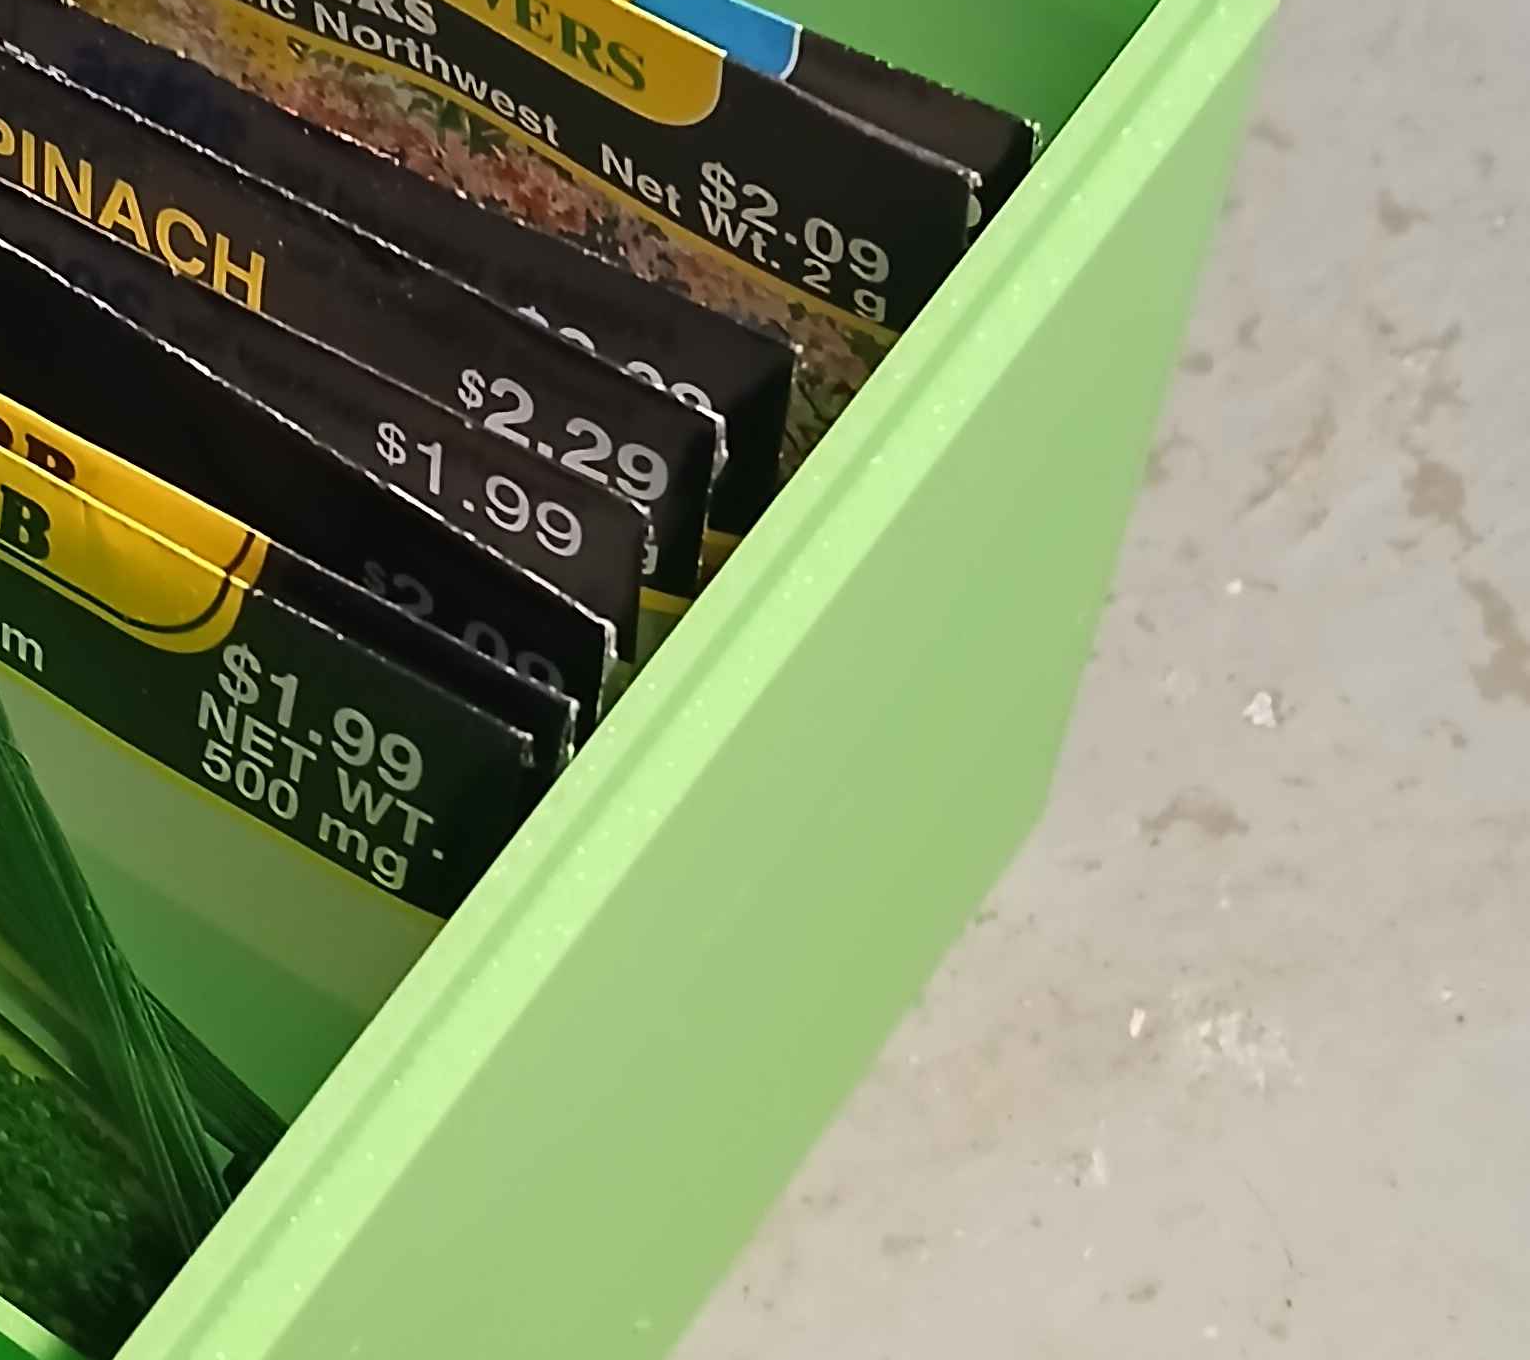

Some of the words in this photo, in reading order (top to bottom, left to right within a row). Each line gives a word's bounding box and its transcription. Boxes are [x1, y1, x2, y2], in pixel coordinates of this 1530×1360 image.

[315, 1, 560, 148] Northwest
[600, 142, 681, 217] Net
[698, 197, 780, 269] Wt.
[803, 258, 833, 295] 2
[855, 288, 888, 324] g
[699, 160, 890, 285] $2.09
[377, 421, 582, 557] $1.99
[457, 368, 669, 501] $2.29
[197, 691, 317, 784] NET
[337, 767, 444, 861] WT.
[218, 643, 423, 792] $1.99
[201, 739, 300, 821] 500
[318, 812, 409, 891] mg
